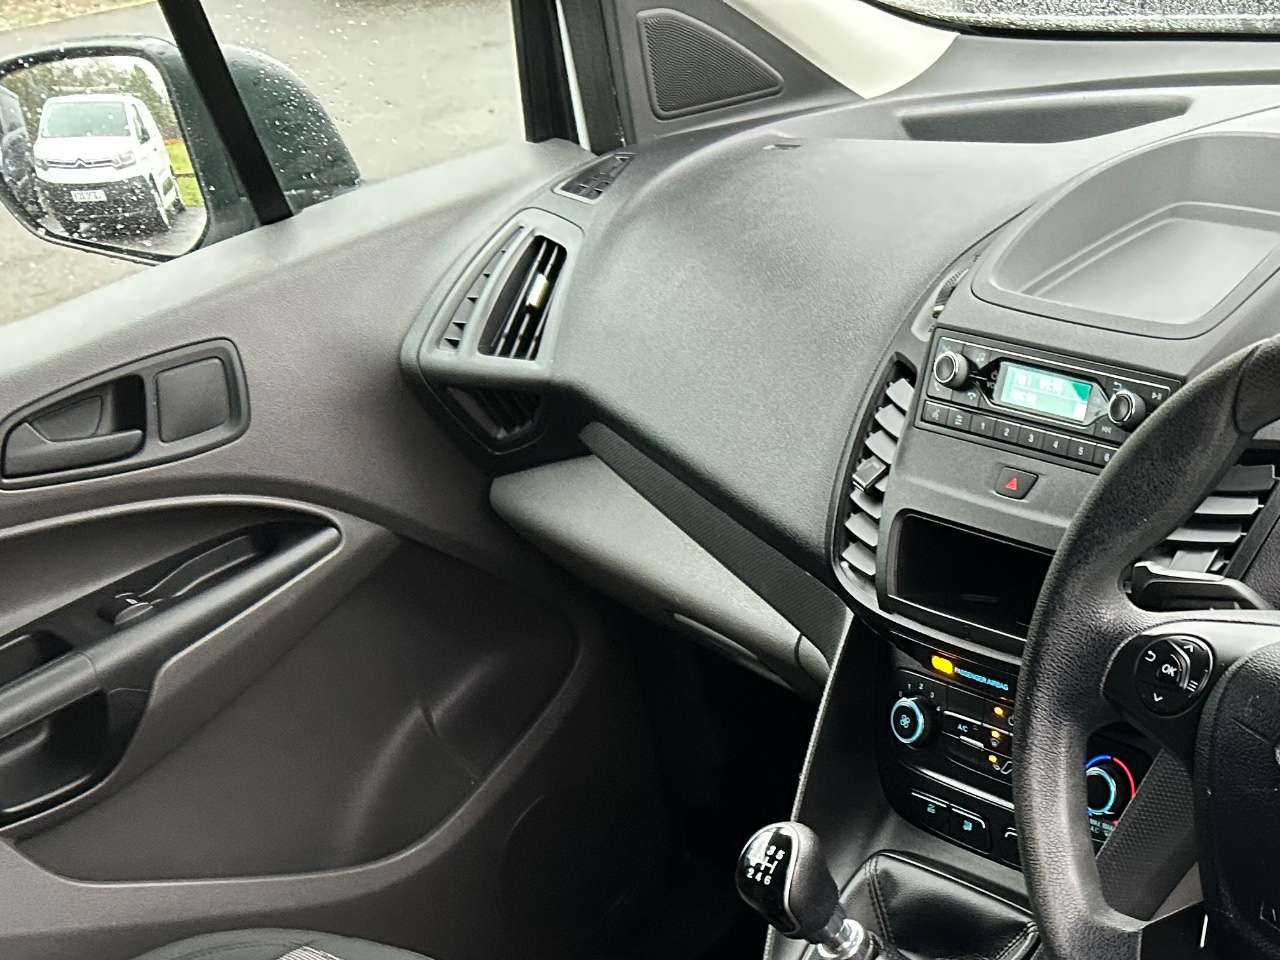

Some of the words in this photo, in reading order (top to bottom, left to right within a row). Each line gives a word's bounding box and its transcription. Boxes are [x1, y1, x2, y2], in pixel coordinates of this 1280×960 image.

[1003, 428, 1010, 437] 2
[1028, 433, 1034, 443] 3
[1053, 440, 1059, 449] 4
[1078, 446, 1084, 456] 5
[1104, 453, 1110, 462] 6
[1161, 664, 1177, 677] OK
[957, 723, 969, 733] A/C
[766, 845, 777, 856] 3
[775, 849, 786, 860] 5
[746, 867, 755, 879] 2
[754, 871, 763, 882] 4
[763, 875, 772, 885] 6
